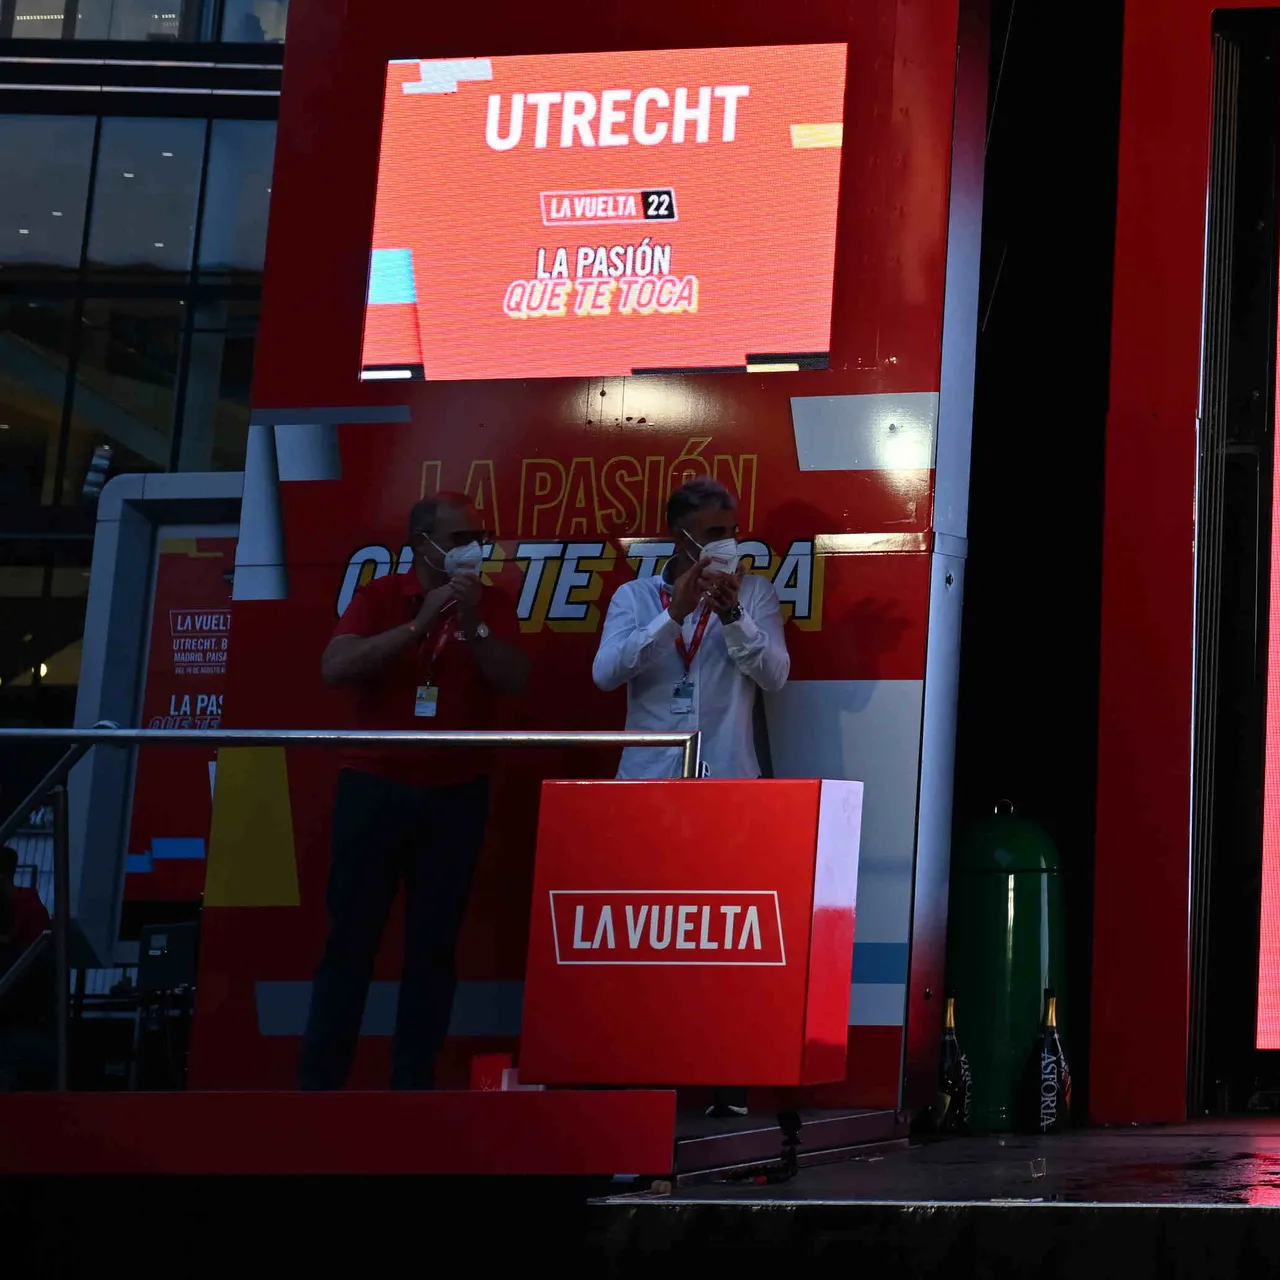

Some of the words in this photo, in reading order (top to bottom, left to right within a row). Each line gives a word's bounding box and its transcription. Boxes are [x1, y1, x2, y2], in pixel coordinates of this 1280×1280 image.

[485, 85, 750, 151] UTRECHT
[550, 198, 571, 218] LA
[573, 196, 637, 217] VUELTA
[647, 194, 670, 215] 22
[537, 248, 569, 279] LA
[576, 237, 672, 278] PASIÓN
[503, 279, 572, 319] QUE
[574, 277, 617, 315] TE
[619, 275, 699, 314] TOCA
[514, 540, 603, 620] TE
[177, 615, 192, 630] LA
[194, 614, 231, 630] VUELT
[170, 694, 191, 716] LA
[573, 905, 616, 949] LA
[625, 905, 762, 950] VUELTA
[1040, 1047, 1058, 1132] ASTORIA
